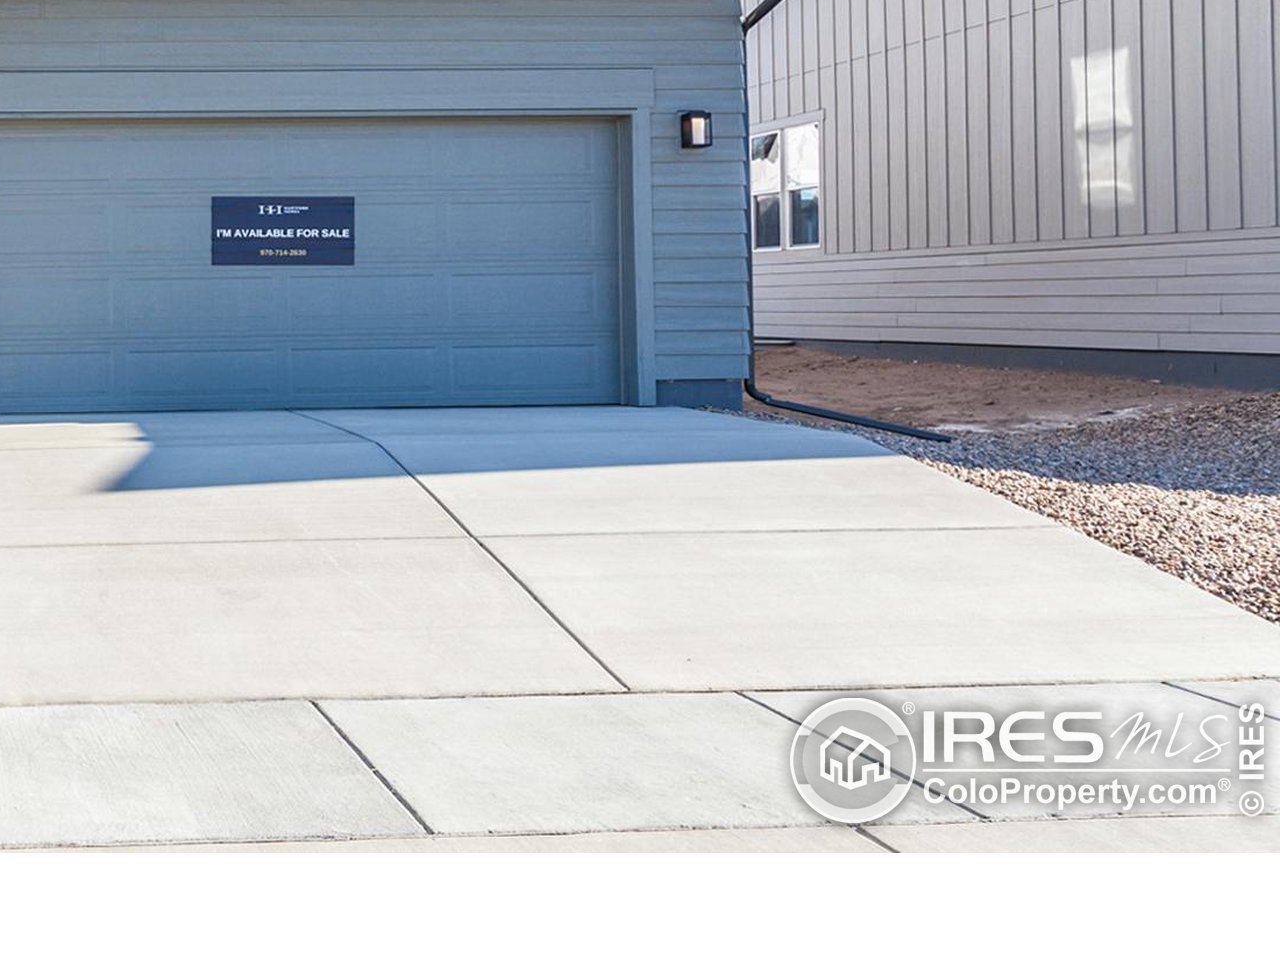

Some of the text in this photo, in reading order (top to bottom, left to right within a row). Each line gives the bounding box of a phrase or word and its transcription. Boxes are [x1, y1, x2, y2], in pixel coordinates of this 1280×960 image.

[216, 228, 350, 238] I'M AVAILABLE FOR SALE
